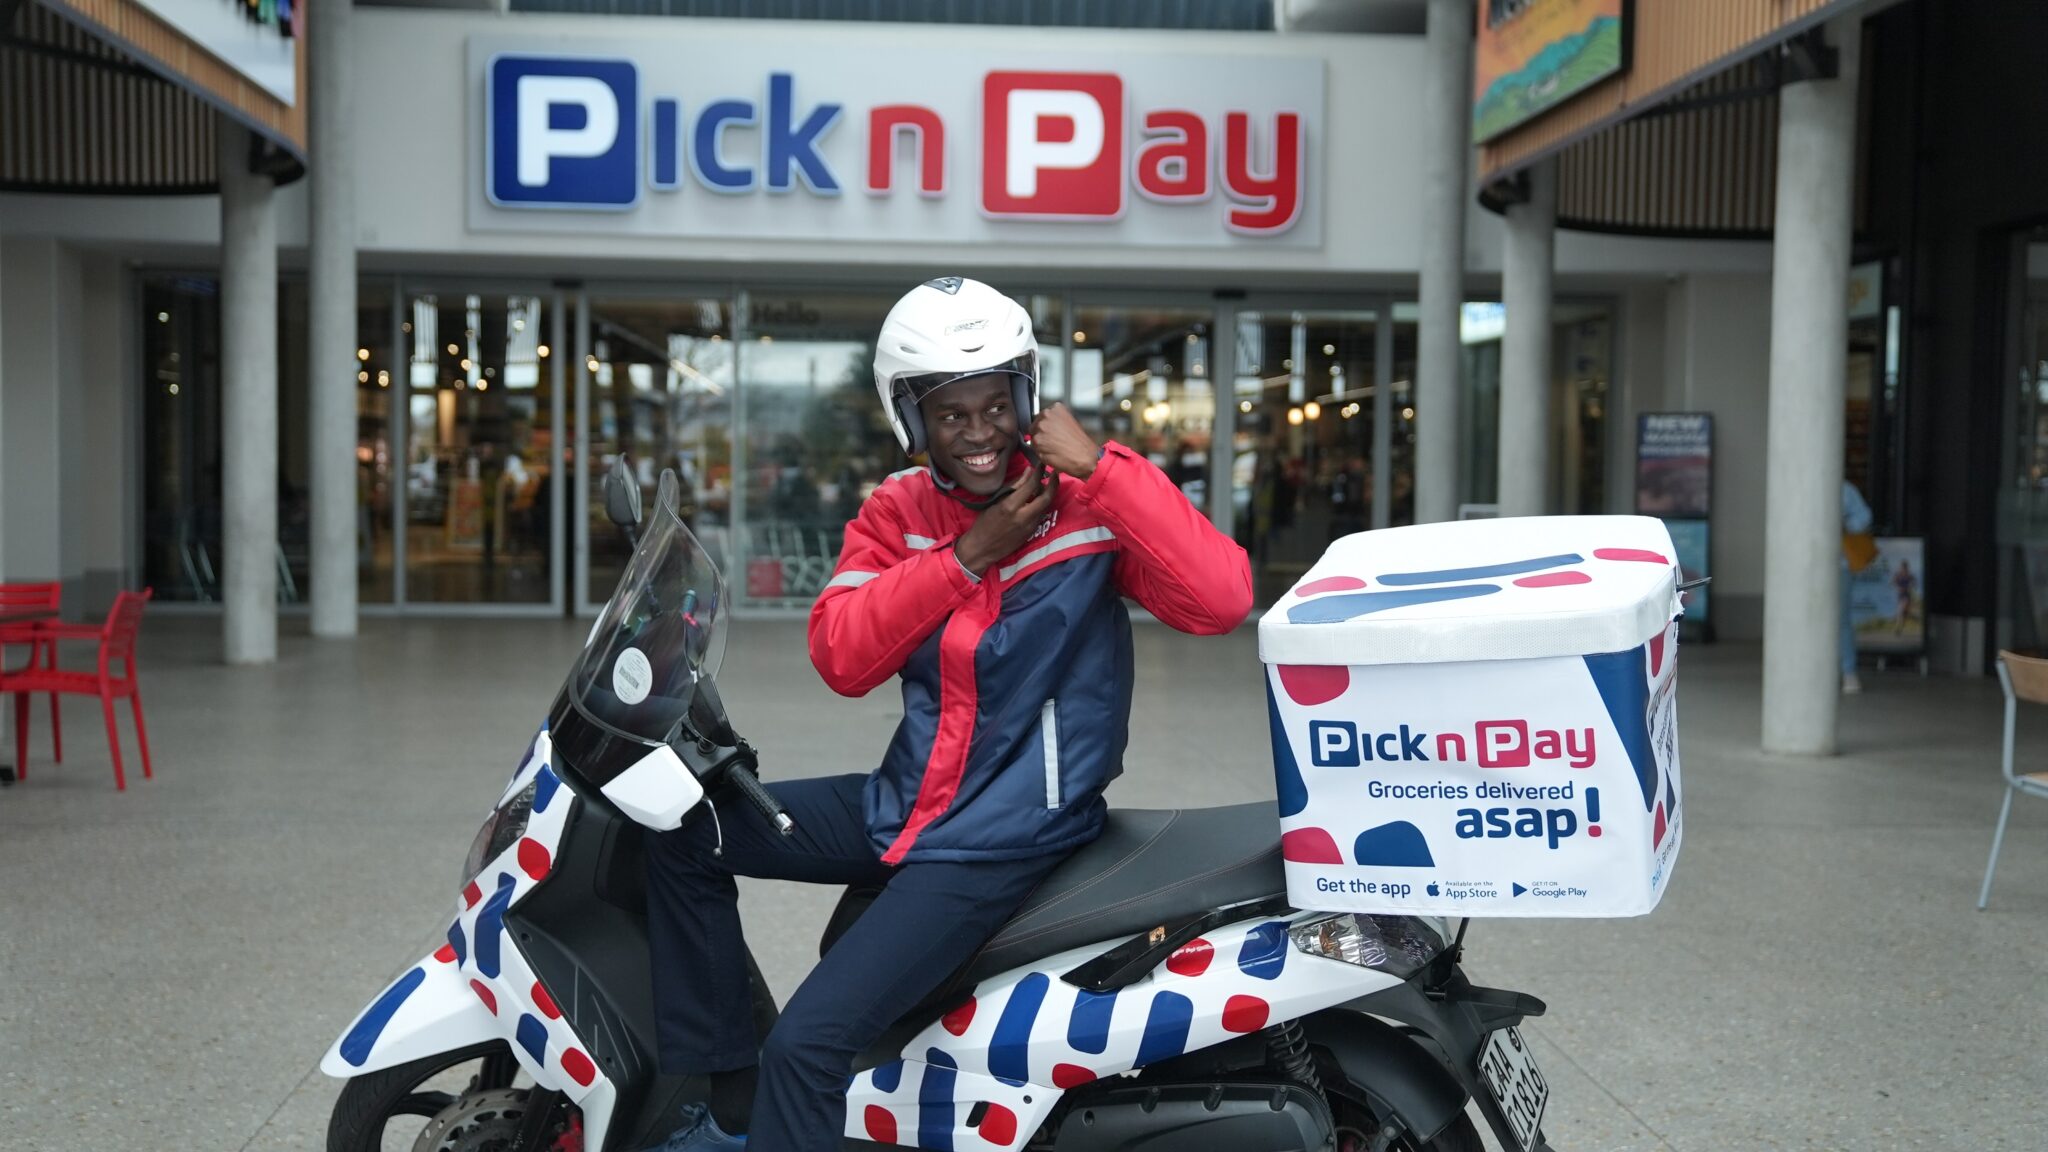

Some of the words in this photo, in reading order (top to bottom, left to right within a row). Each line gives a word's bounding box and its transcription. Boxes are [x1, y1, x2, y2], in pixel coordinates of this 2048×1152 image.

[490, 56, 843, 208] Pick
[866, 104, 945, 195] n
[982, 70, 1303, 235] Pay
[1309, 720, 1431, 768] Pick
[1435, 732, 1467, 762] n
[1474, 719, 1597, 769] Pay
[1368, 781, 1468, 801] Groceries
[1474, 781, 1574, 801] delivered
[1455, 786, 1603, 850] asap!
[1316, 877, 1346, 893] Get
[1349, 879, 1378, 894] the
[1380, 883, 1411, 899] app
[1445, 888, 1468, 900] App
[1469, 888, 1498, 898] Store
[1532, 887, 1567, 899] Google
[1568, 887, 1587, 898] Play
[1483, 1038, 1514, 1103] CAA
[1506, 1057, 1544, 1147] 01816
